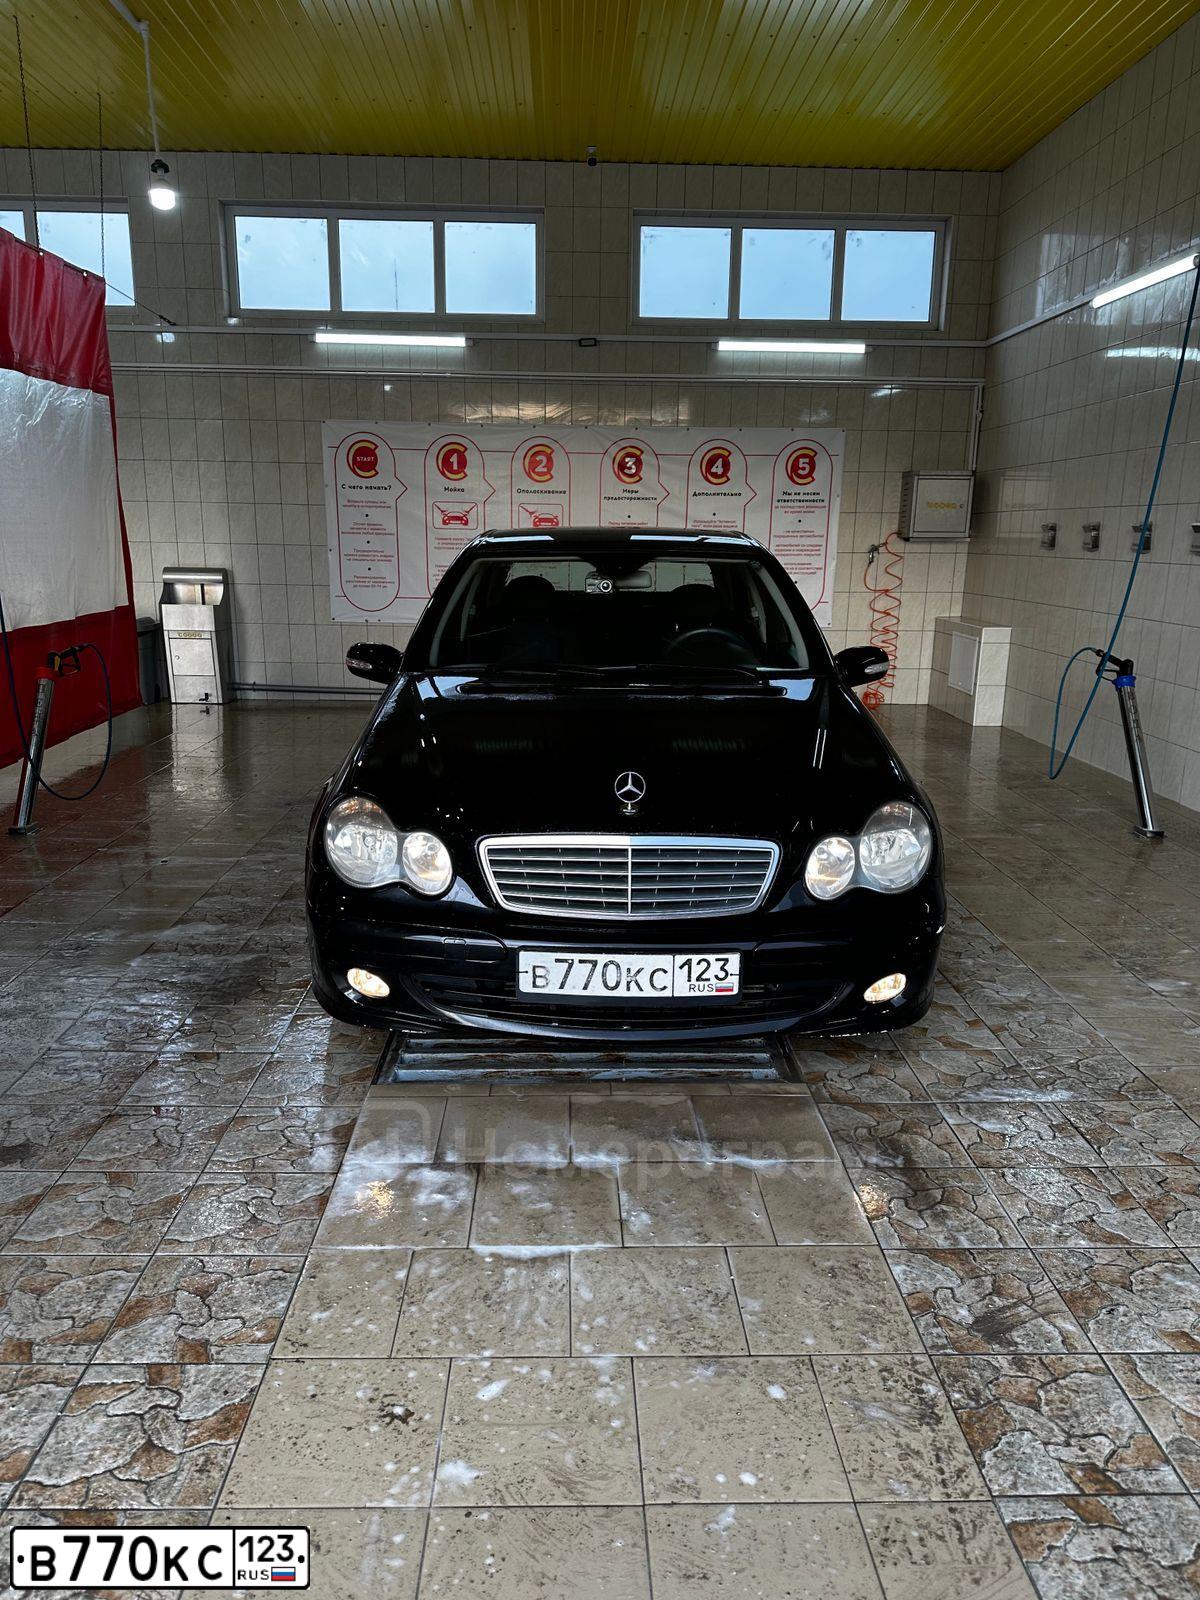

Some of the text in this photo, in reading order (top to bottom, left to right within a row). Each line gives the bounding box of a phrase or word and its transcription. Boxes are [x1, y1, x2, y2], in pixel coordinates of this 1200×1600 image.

[449, 453, 458, 470] 1
[535, 455, 547, 472] 2
[623, 457, 637, 475] 3
[710, 457, 724, 475] 4
[798, 457, 811, 476] 5
[364, 484, 392, 492] начать?
[678, 957, 730, 983] 123
[688, 983, 714, 993] RUS
